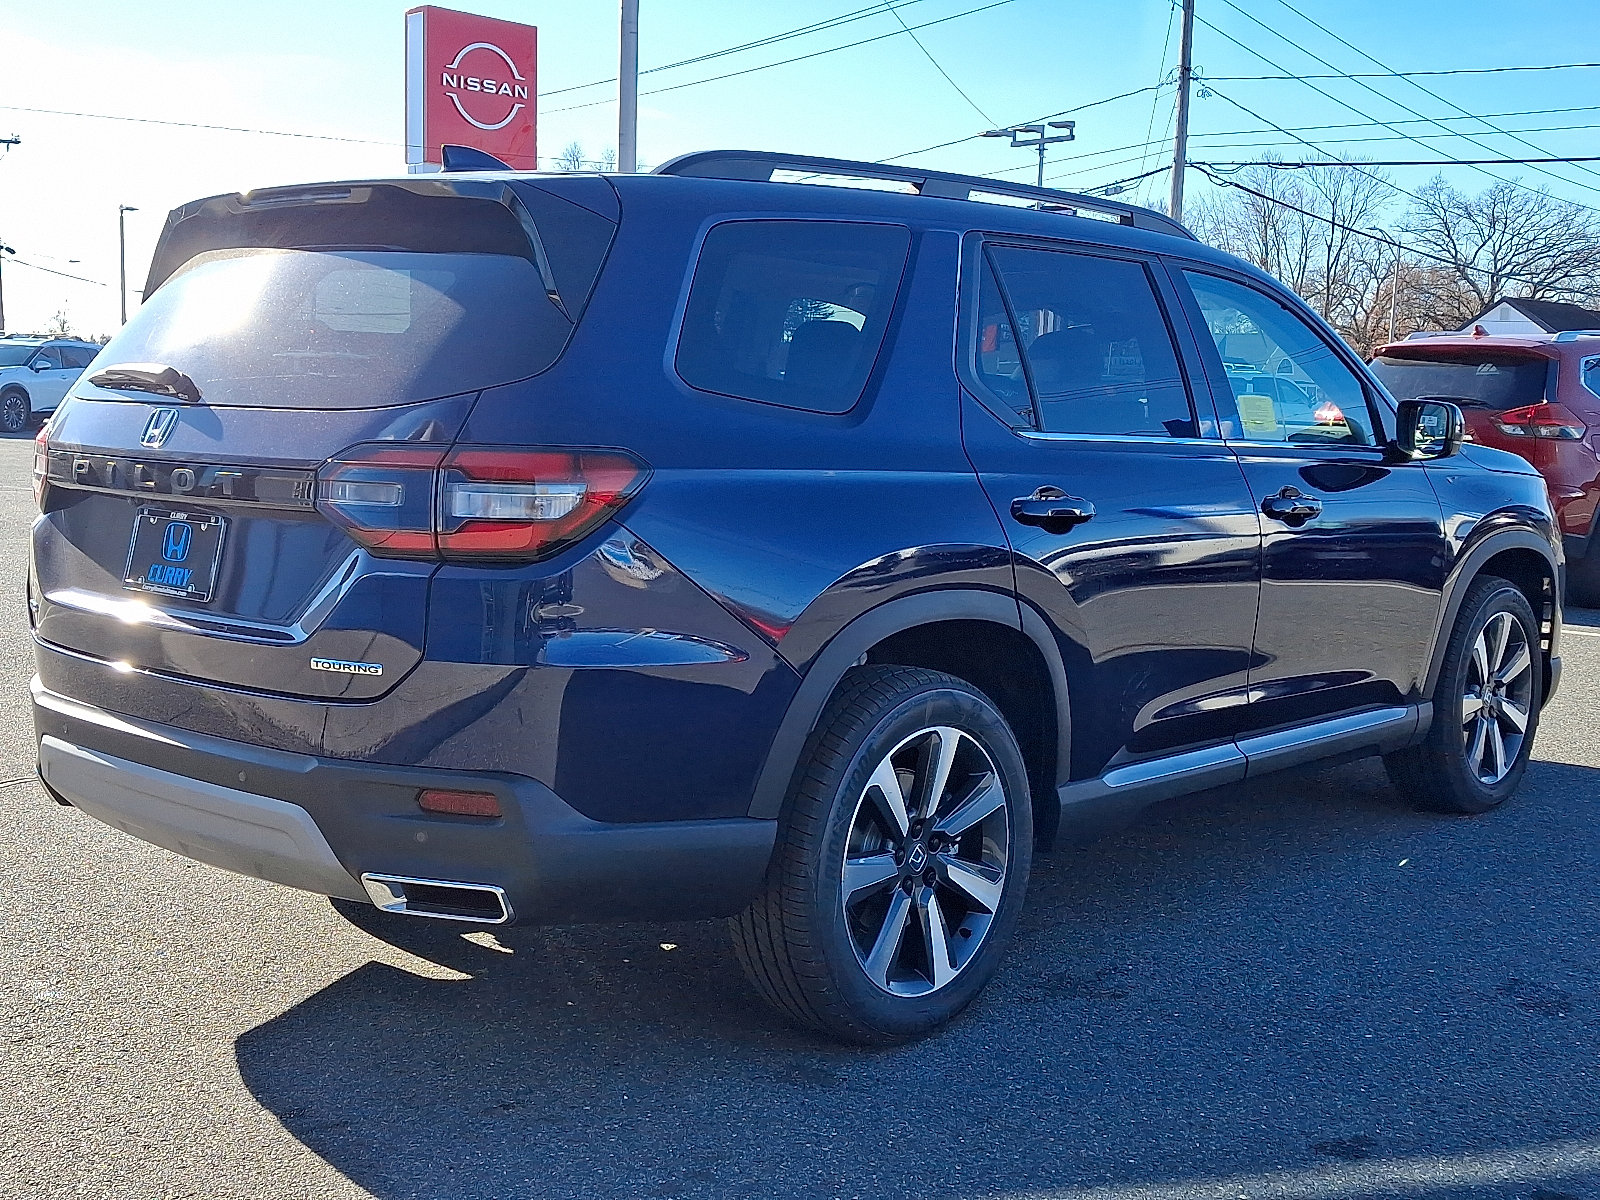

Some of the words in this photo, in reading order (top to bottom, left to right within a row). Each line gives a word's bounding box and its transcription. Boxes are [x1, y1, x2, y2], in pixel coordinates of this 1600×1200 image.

[442, 72, 528, 100] NISSAN
[73, 459, 242, 496] PILOT
[147, 563, 193, 587] CURRY
[312, 660, 379, 674] TOURING
